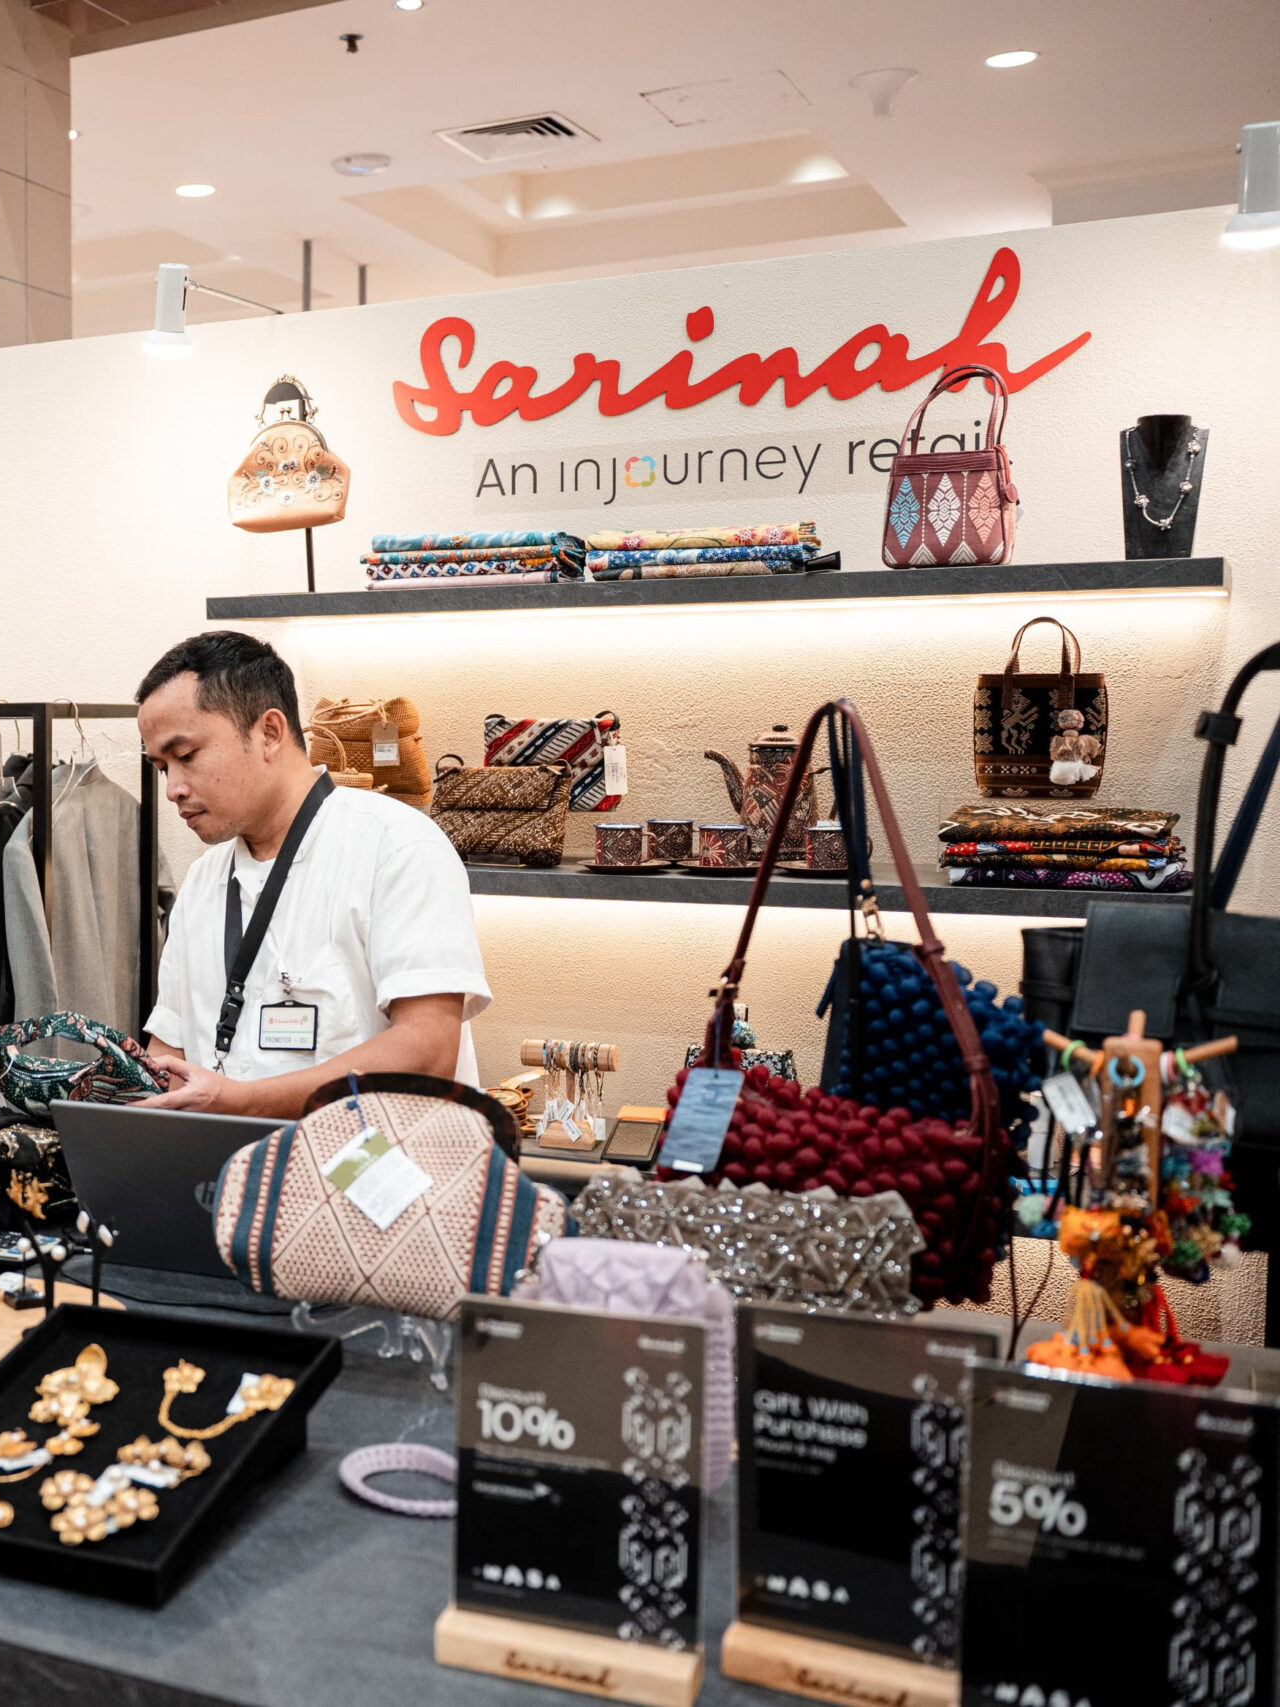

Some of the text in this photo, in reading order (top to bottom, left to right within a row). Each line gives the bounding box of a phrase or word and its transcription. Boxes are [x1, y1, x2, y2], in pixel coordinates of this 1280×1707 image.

[392, 247, 1091, 436] Sarinah
[476, 458, 538, 499] An
[848, 420, 998, 475] retai
[476, 1400, 576, 1450] 10%
[989, 1480, 1088, 1537] 5%
